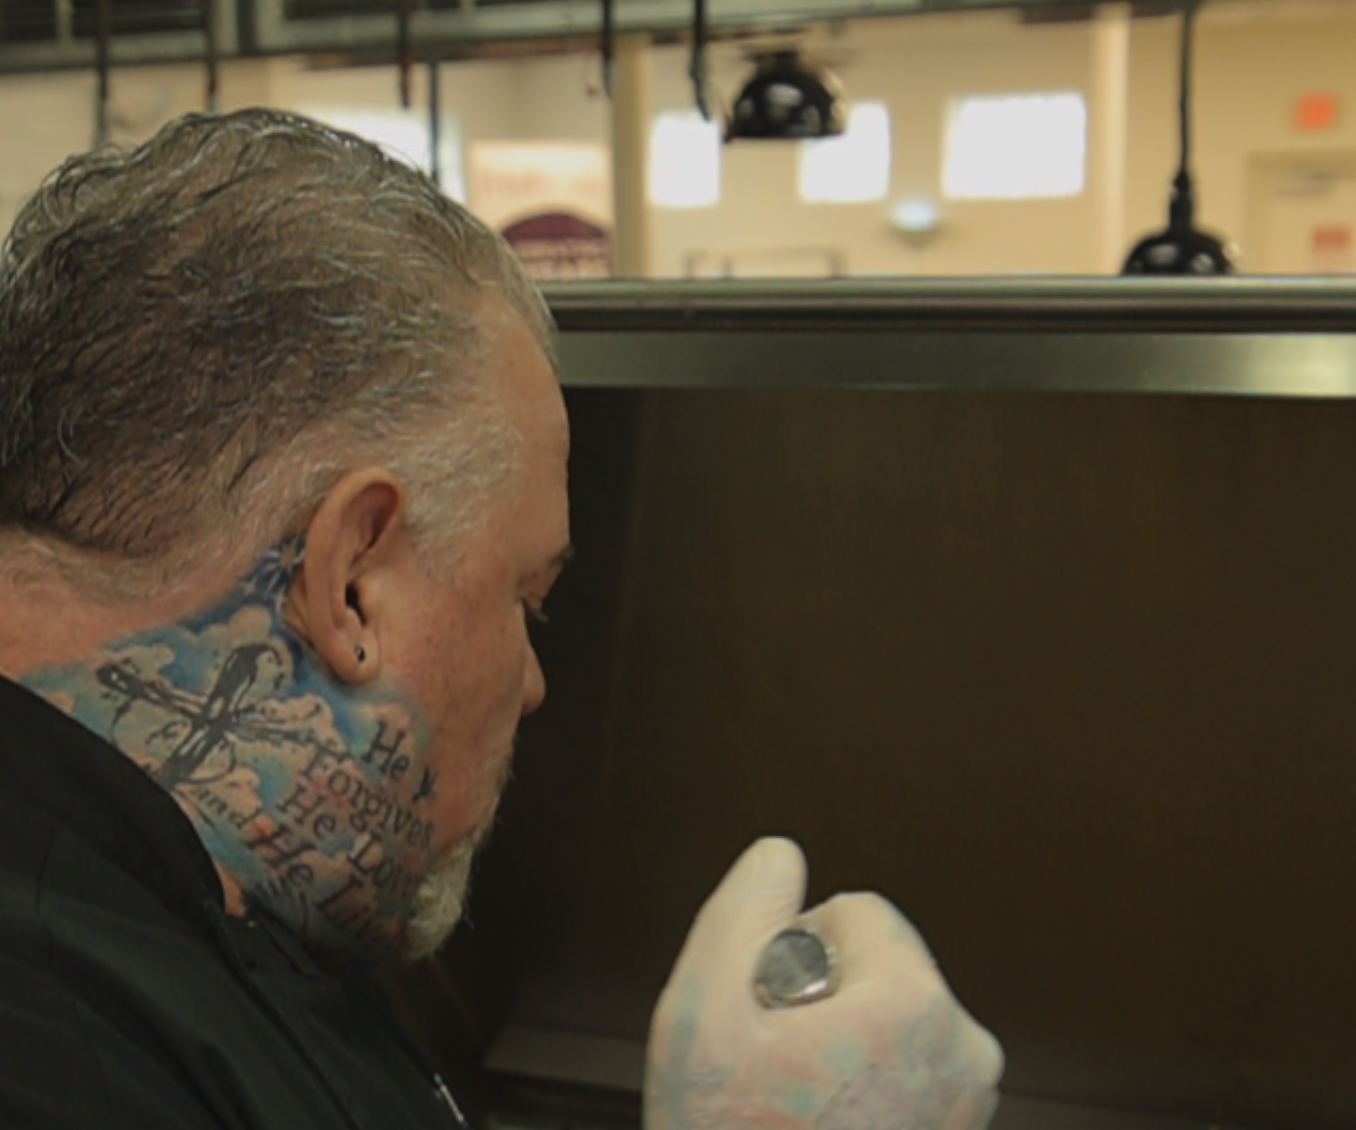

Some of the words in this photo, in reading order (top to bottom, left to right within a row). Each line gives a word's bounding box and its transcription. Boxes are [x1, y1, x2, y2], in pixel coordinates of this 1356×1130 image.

[361, 719, 411, 782] He
[277, 787, 338, 839] He
[301, 744, 436, 850] Forgives
[249, 821, 316, 891] He
